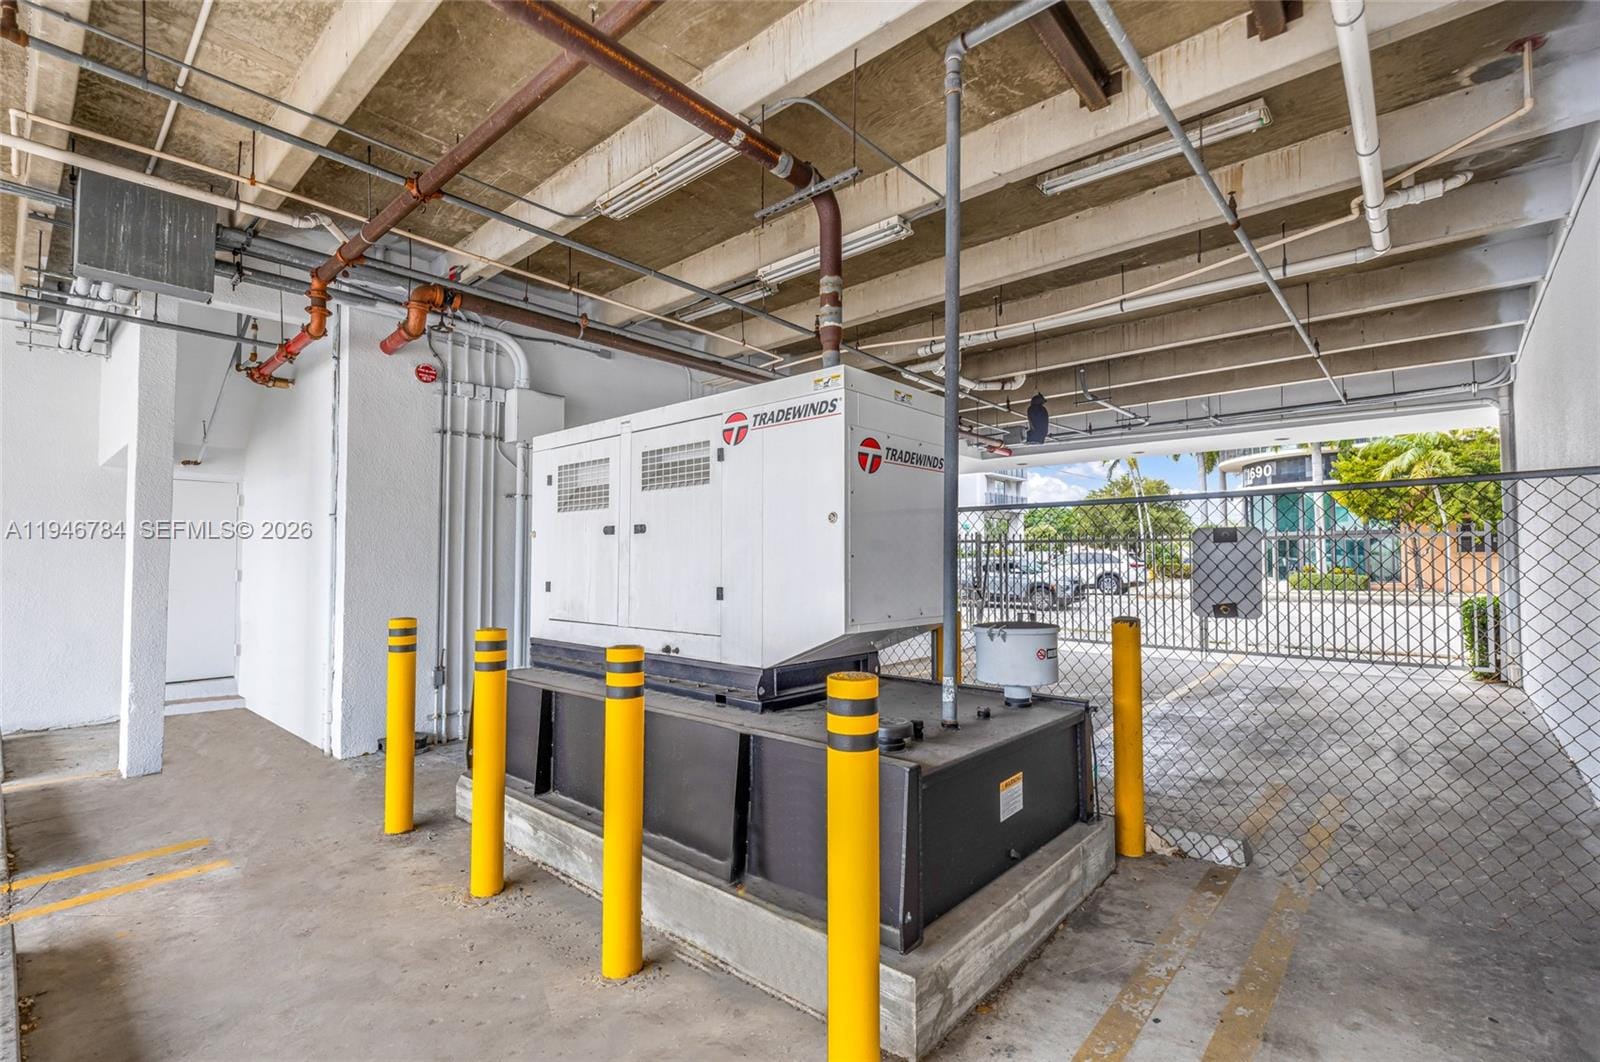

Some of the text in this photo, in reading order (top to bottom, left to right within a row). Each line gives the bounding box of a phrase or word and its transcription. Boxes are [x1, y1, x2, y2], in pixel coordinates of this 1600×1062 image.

[752, 398, 838, 427] TRADEWINDS
[885, 447, 945, 470] TRADEWINDS
[1246, 464, 1272, 480] 1690
